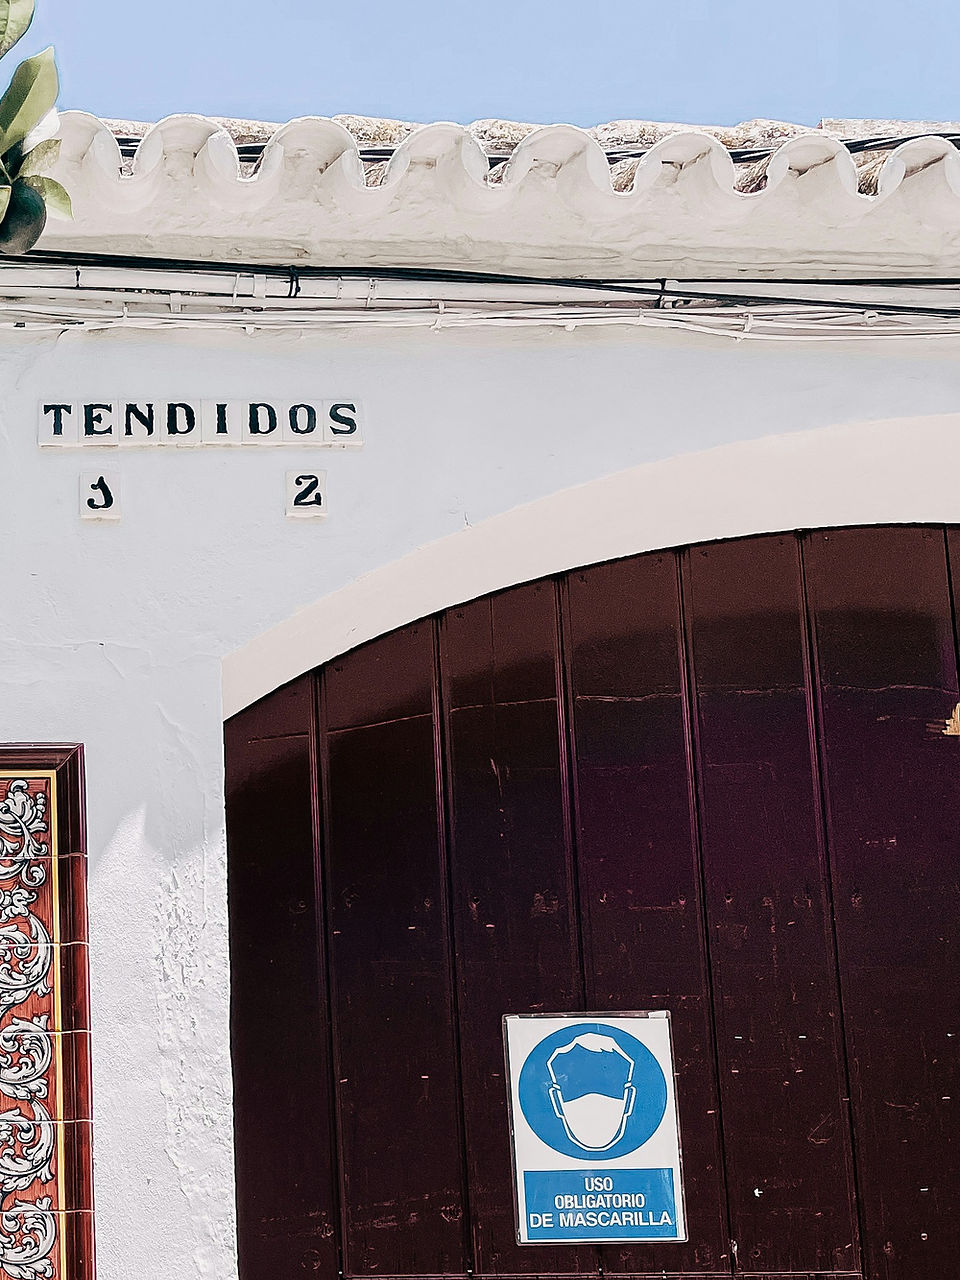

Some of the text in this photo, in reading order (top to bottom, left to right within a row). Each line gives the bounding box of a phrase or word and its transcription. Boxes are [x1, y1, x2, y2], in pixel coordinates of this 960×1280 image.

[42, 402, 358, 436] TENDIDOS
[292, 474, 323, 507] 2
[584, 1176, 614, 1192] USO
[553, 1193, 646, 1210] OBLIGATORIO
[529, 1210, 674, 1229] DE MASCARILLA
